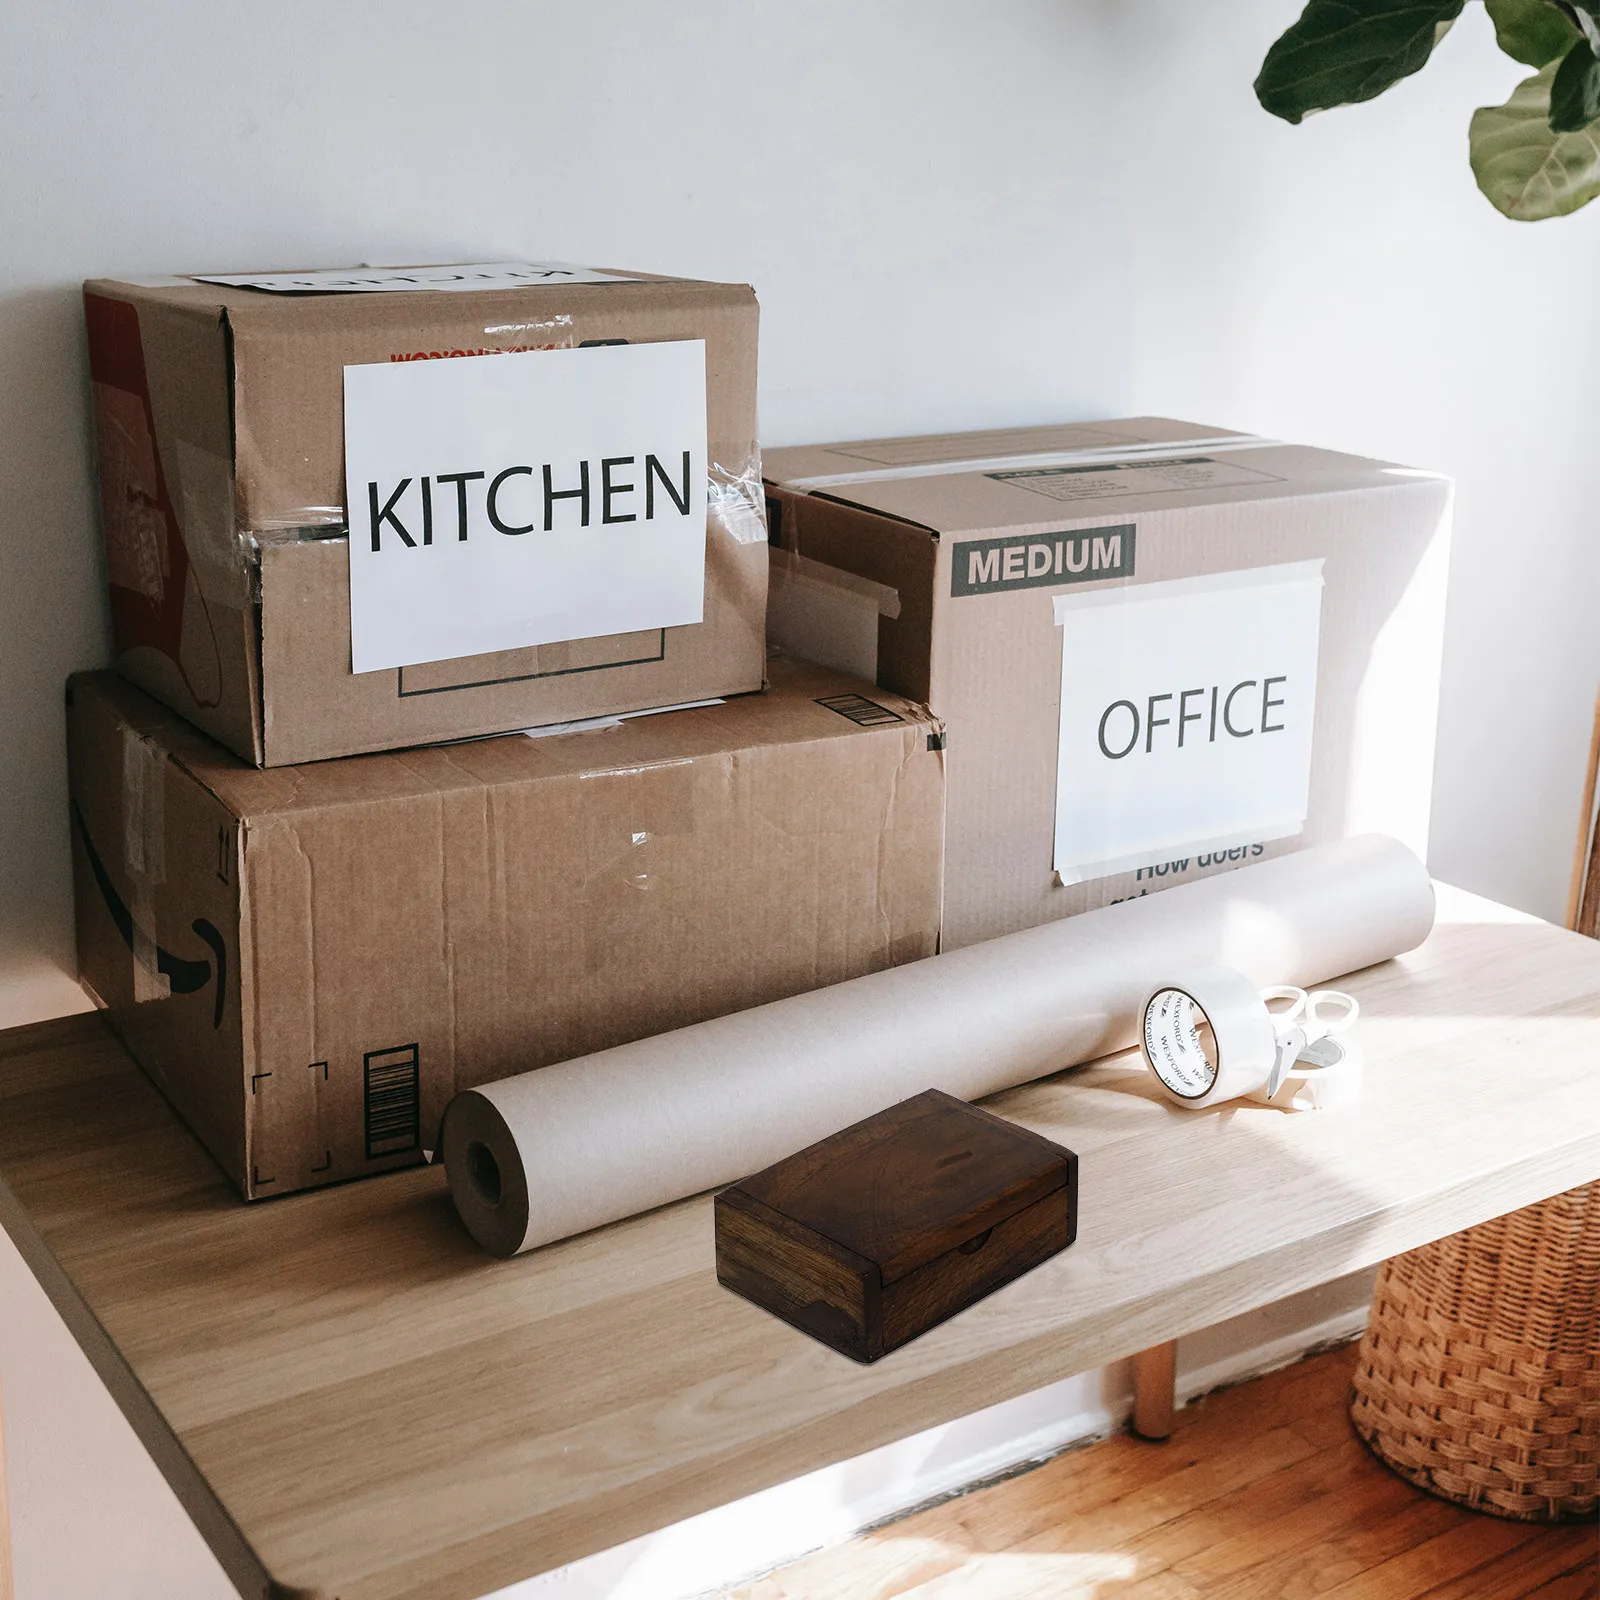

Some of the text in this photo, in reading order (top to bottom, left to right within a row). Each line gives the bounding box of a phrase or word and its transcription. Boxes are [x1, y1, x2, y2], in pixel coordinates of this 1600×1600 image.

[368, 451, 691, 552] KITCHEN
[968, 535, 1121, 584] MEDIUM
[1098, 676, 1287, 759] OFFICE
